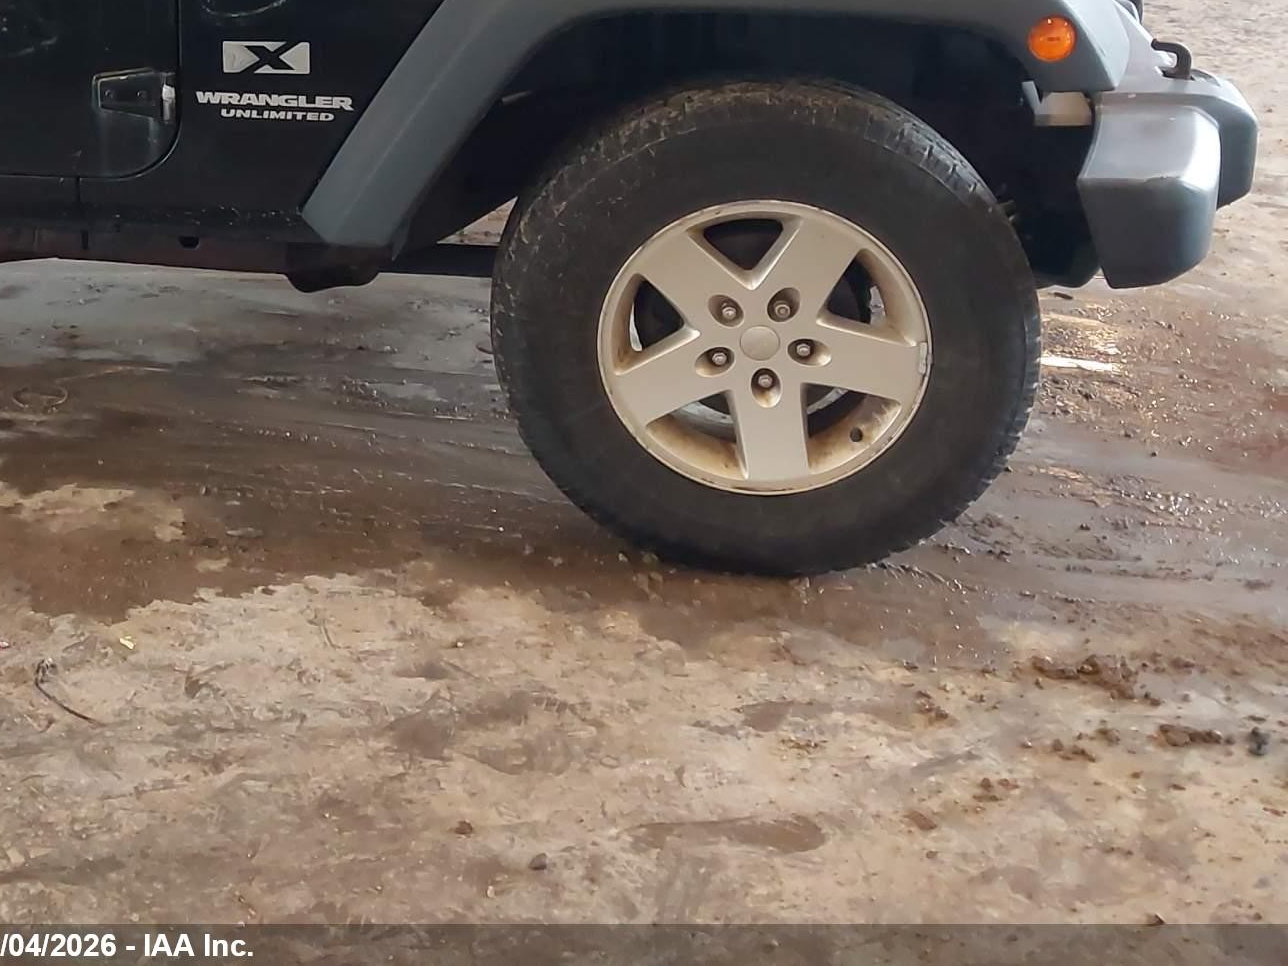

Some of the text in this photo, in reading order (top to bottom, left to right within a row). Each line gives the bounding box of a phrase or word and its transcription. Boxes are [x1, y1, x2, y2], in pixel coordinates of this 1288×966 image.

[229, 41, 308, 74] X
[196, 90, 354, 111] WRANGLER
[220, 108, 335, 121] UNLIMITED
